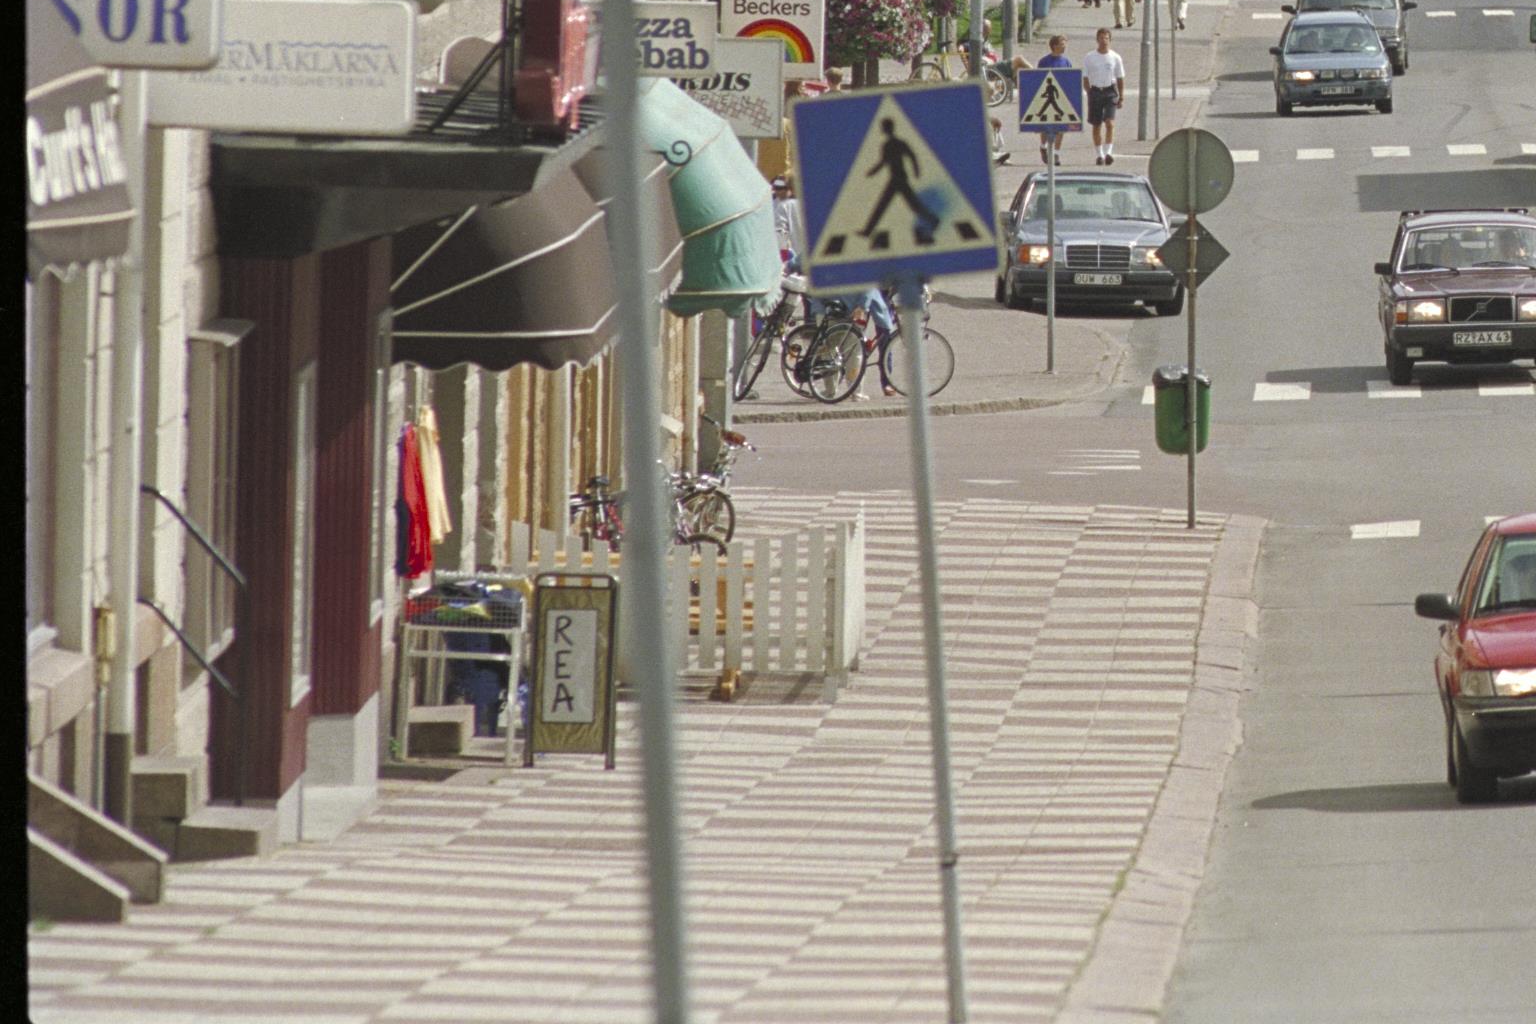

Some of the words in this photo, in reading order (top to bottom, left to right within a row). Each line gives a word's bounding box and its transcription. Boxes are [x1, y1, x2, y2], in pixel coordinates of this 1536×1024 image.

[634, 17, 692, 38] zza
[221, 41, 400, 76] RMÄKLARNA
[634, 40, 710, 70] bab
[551, 614, 574, 715] REA
